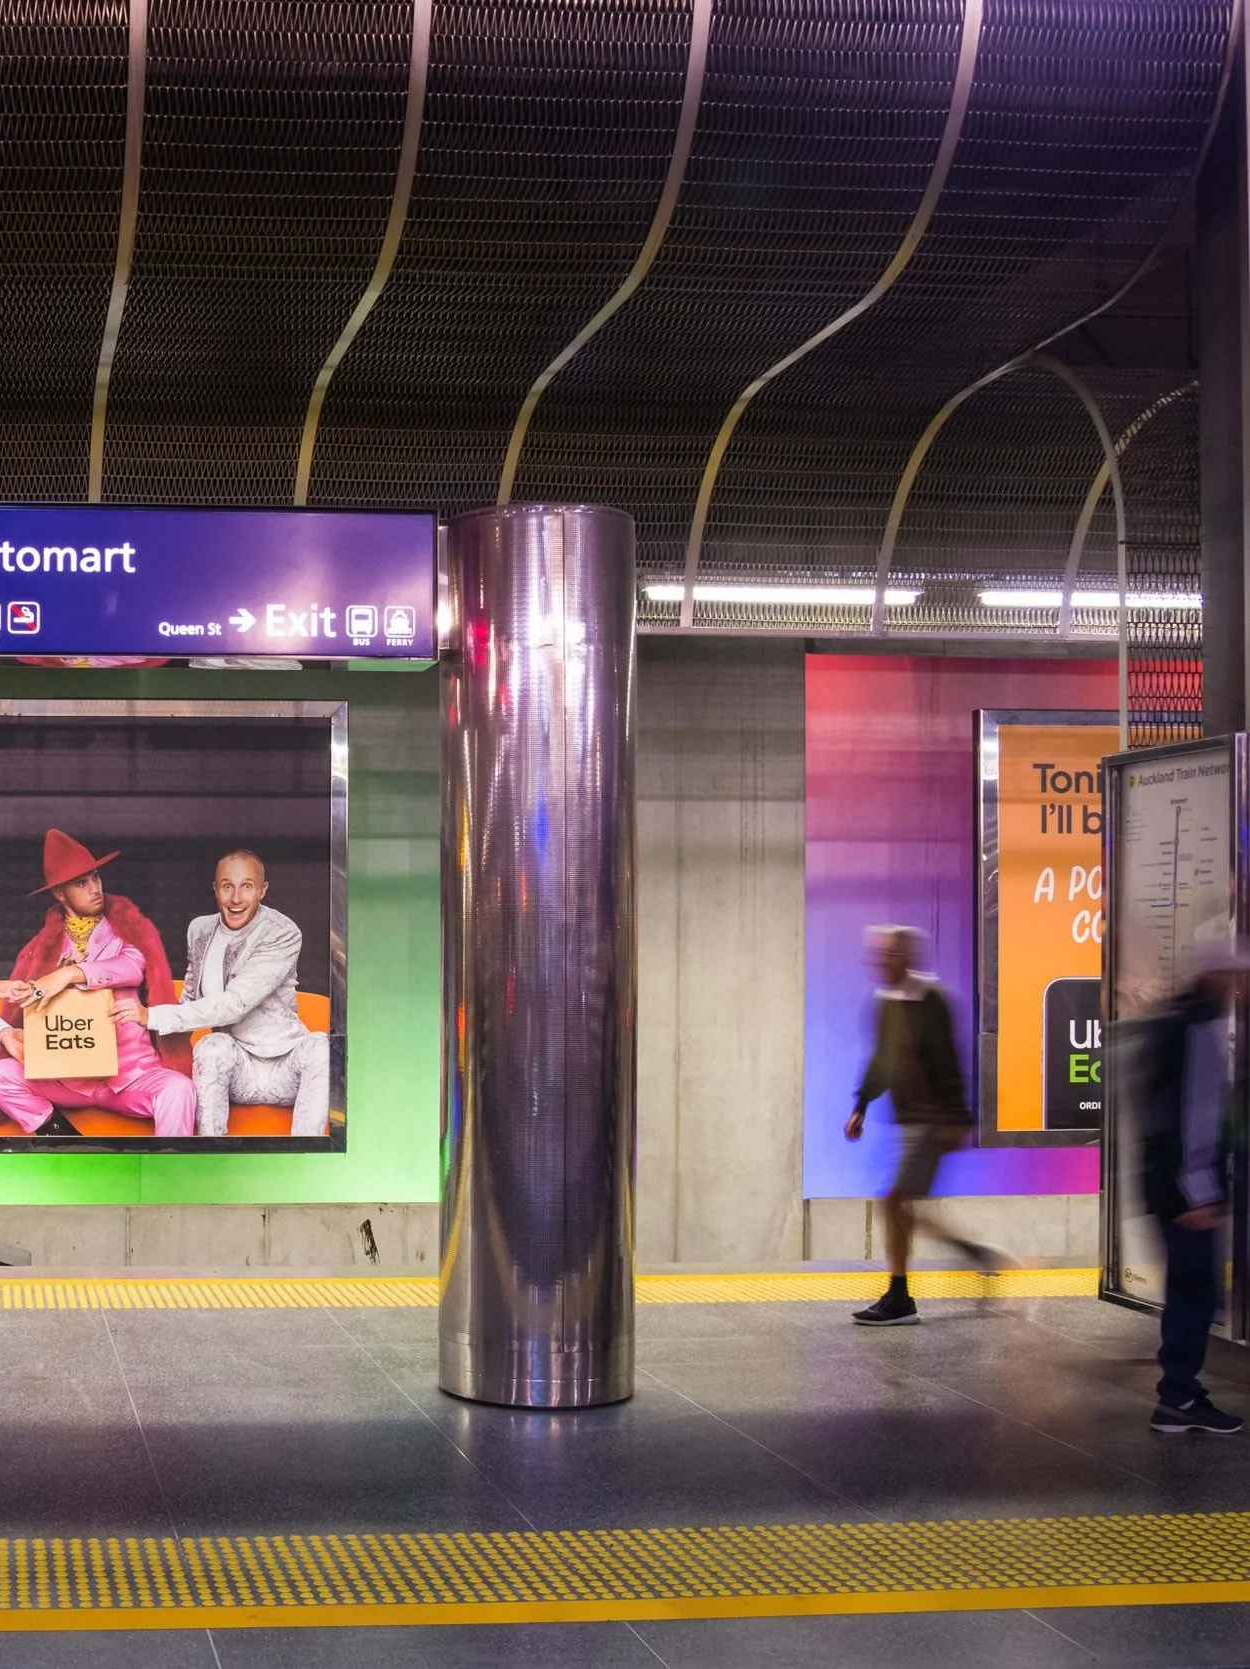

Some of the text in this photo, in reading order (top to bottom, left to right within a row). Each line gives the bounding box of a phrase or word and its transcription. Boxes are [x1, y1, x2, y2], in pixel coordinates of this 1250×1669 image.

[158, 604, 336, 637] Queen St Exit
[352, 638, 371, 646] BUS
[387, 638, 414, 646] FERRY
[1138, 768, 1174, 786] Auckland
[1176, 765, 1196, 780] Train
[1033, 866, 1055, 904] A
[44, 1014, 94, 1032] Uber
[45, 1034, 96, 1050] Eats
